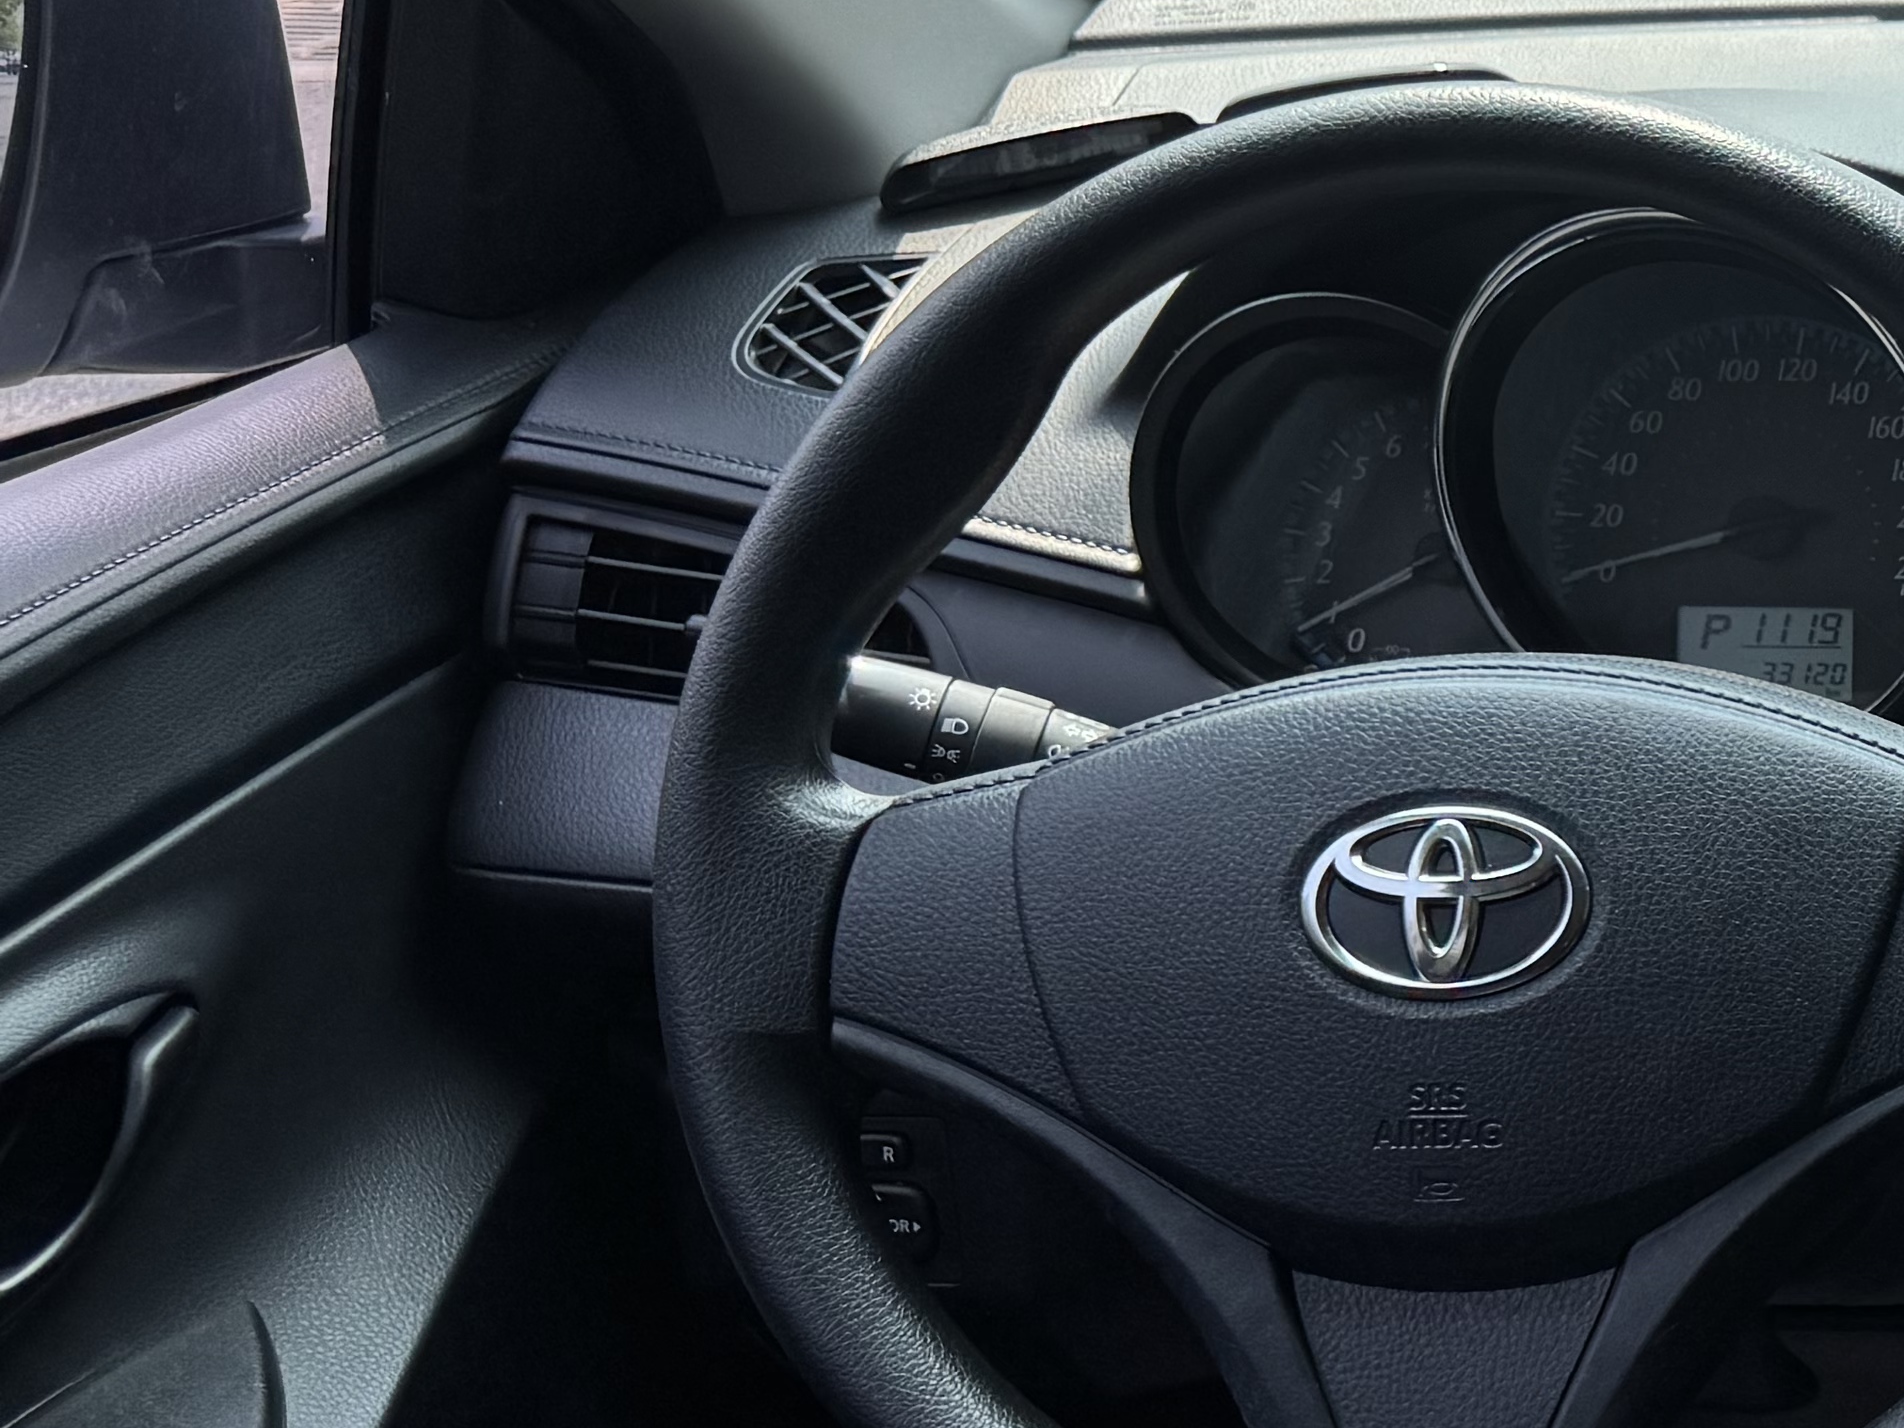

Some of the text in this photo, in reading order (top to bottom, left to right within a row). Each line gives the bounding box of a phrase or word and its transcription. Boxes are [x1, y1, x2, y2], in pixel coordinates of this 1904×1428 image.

[1717, 359, 1760, 382] 100
[1778, 358, 1818, 381] 120
[1667, 378, 1703, 402] 80
[1828, 381, 1871, 406] 140
[1629, 410, 1664, 434] 60
[1384, 435, 1403, 458] 6
[1351, 456, 1369, 482] 5
[1601, 453, 1639, 477] 40
[1325, 486, 1344, 510] 4
[1589, 504, 1625, 529] 20
[1315, 525, 1332, 548] 3
[1315, 561, 1332, 584] 2
[1599, 560, 1617, 584] 0
[1347, 628, 1366, 653] 0
[1700, 612, 1843, 650] P 1119
[1762, 661, 1848, 686] 33120
[1408, 1082, 1468, 1111] SRS
[1372, 1119, 1505, 1150] AIRBAG
